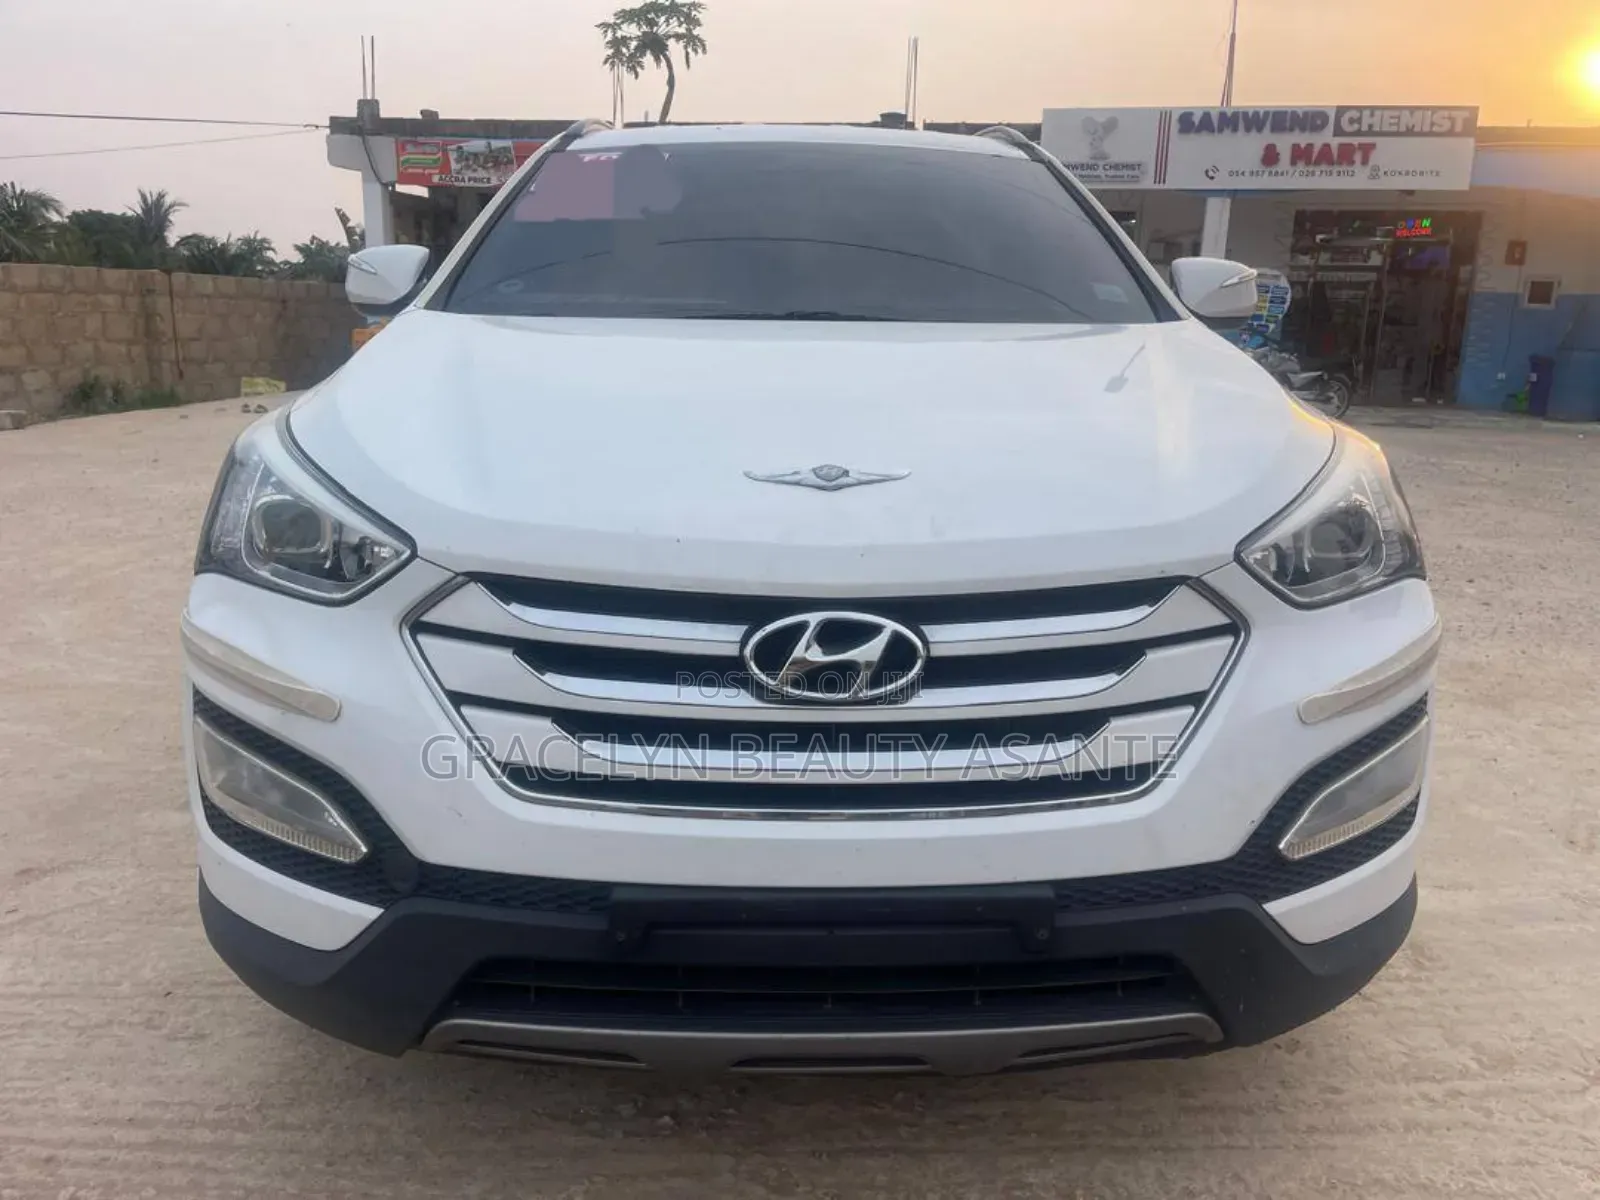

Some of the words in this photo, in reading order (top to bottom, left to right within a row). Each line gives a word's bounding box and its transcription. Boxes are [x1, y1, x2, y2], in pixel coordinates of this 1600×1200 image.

[1178, 110, 1330, 134] SAMWEND
[1341, 109, 1470, 132] CHEMIST
[1261, 143, 1280, 167] &
[1290, 142, 1377, 167] MART
[1103, 163, 1141, 171] CHEMIST
[468, 175, 491, 184] PRICE
